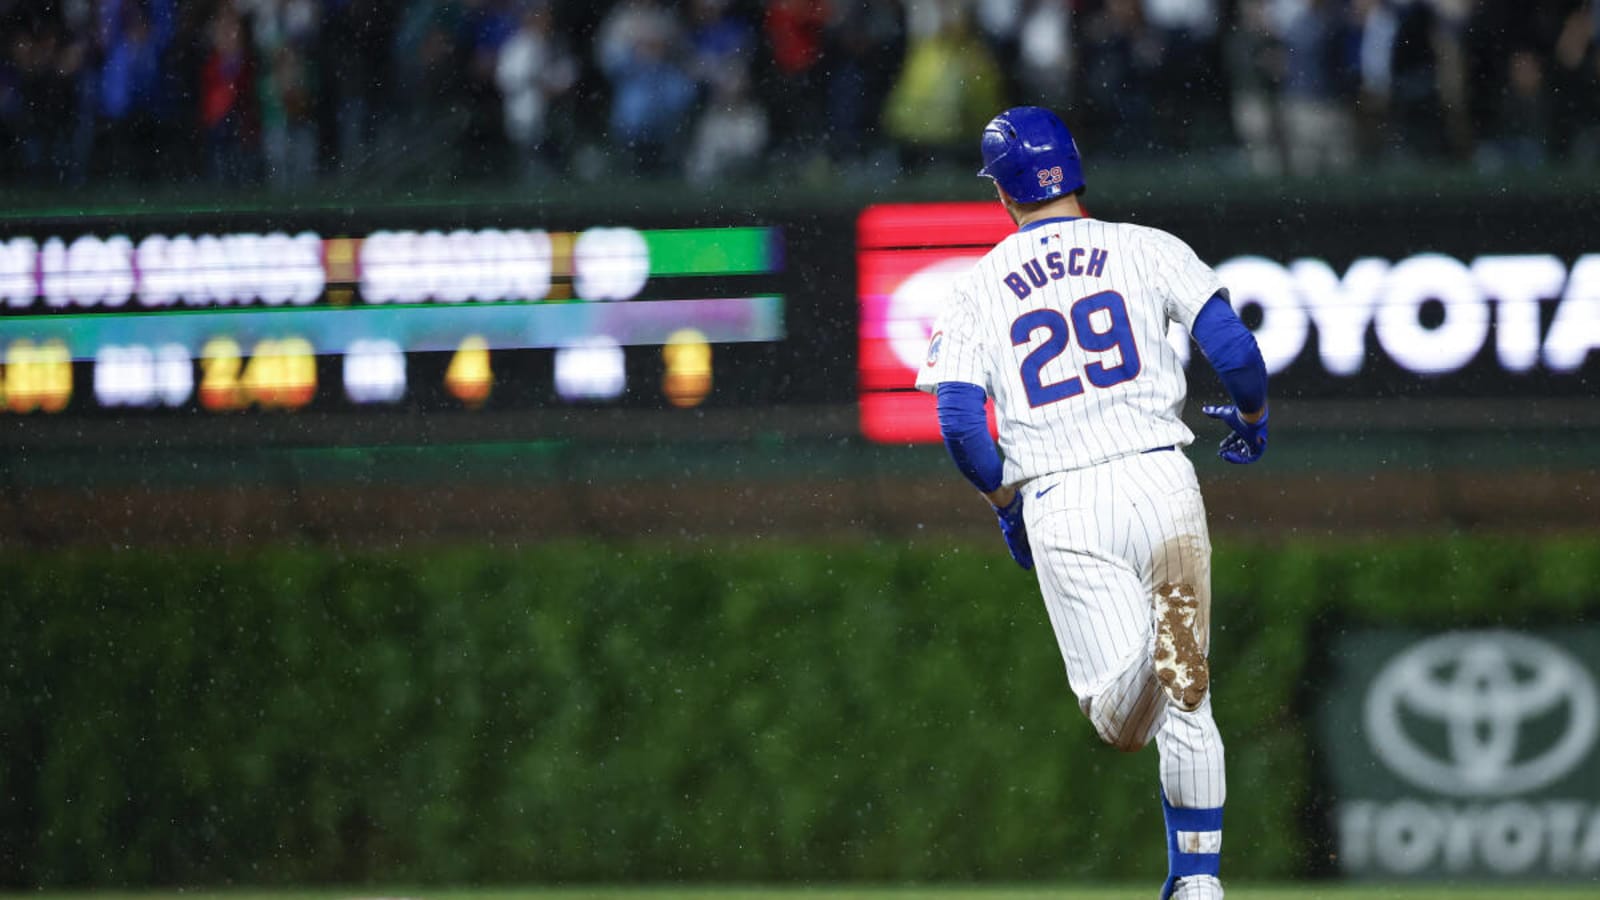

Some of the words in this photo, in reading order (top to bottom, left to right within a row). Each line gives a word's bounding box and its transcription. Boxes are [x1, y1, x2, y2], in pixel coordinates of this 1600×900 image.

[1038, 166, 1064, 188] 29
[1003, 247, 1109, 301] BUSCH
[1167, 252, 1600, 376] OYOTA
[1010, 289, 1142, 409] 29
